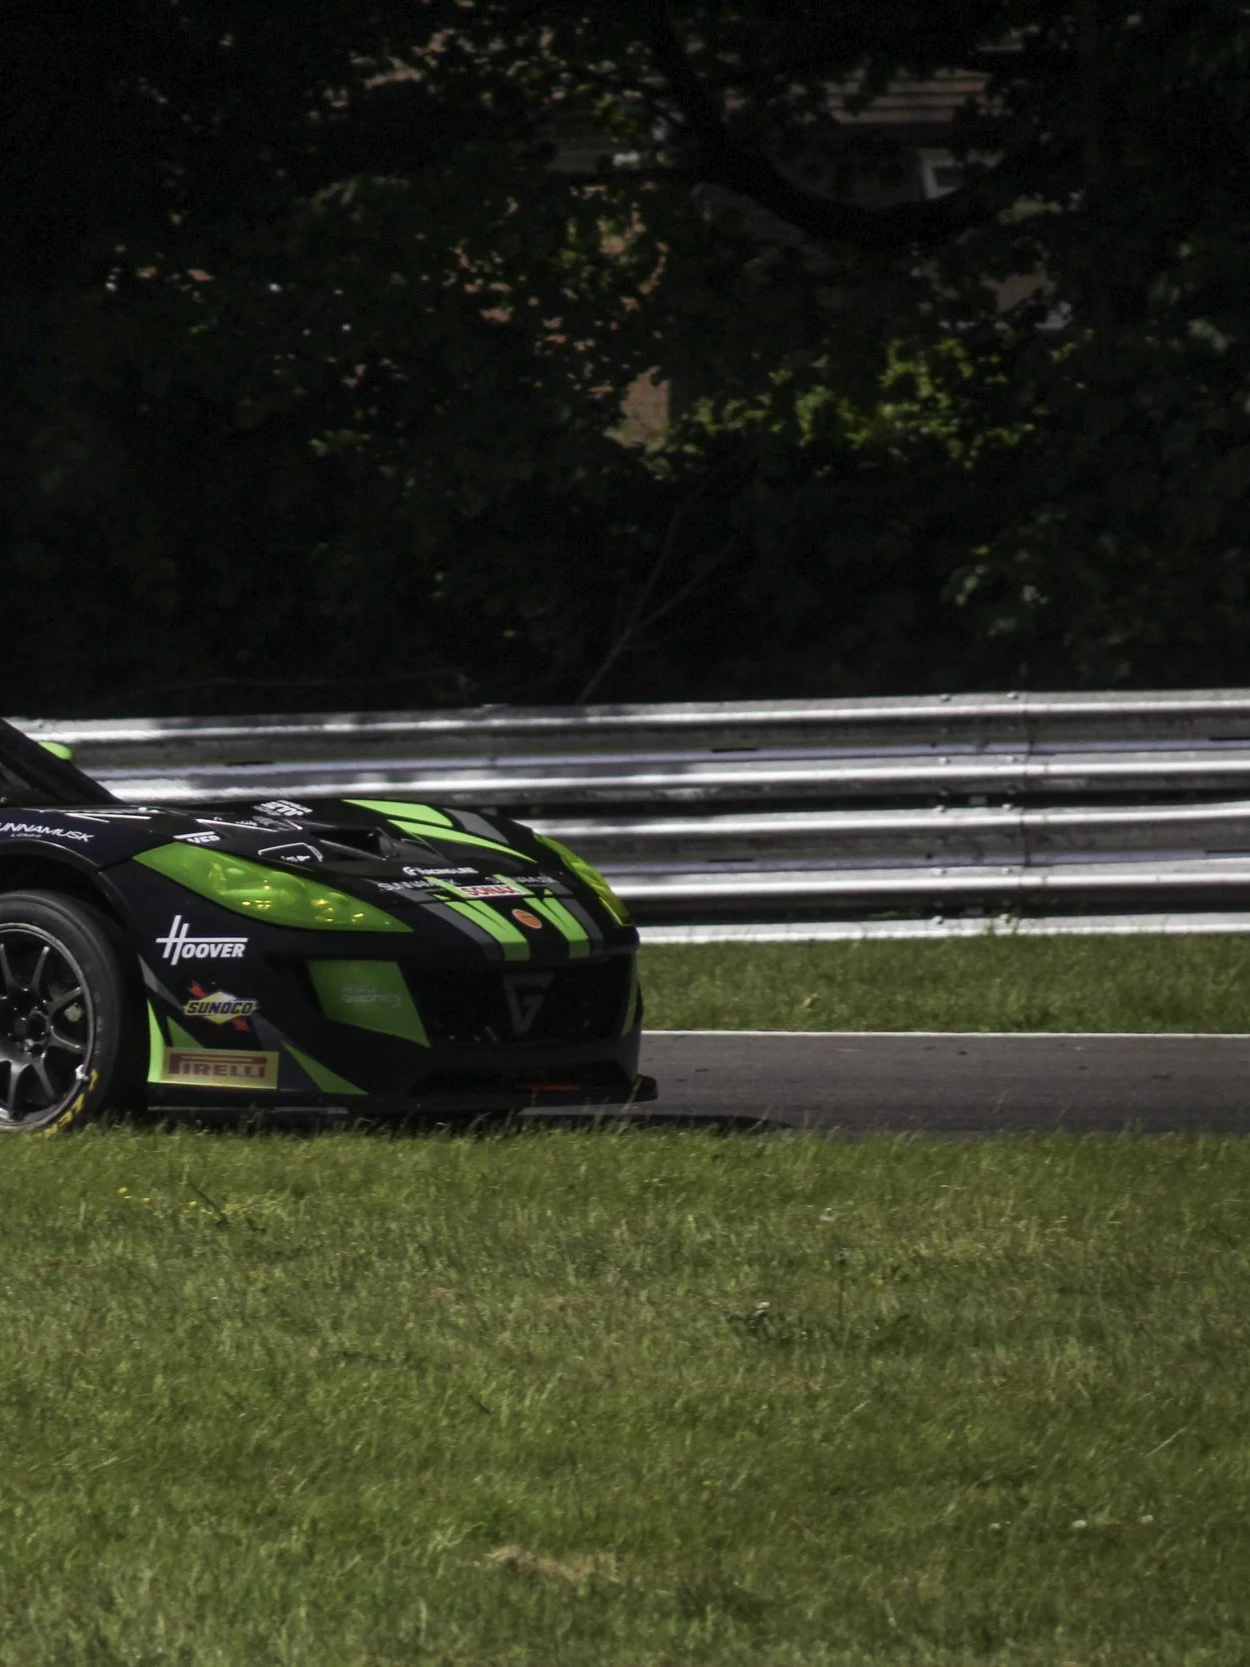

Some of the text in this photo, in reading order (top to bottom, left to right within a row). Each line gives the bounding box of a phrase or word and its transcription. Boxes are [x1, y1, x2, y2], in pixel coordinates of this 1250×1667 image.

[155, 915, 248, 965] HOOVER
[186, 1001, 255, 1014] SUNOCO
[169, 1053, 267, 1078] PIRELLI
